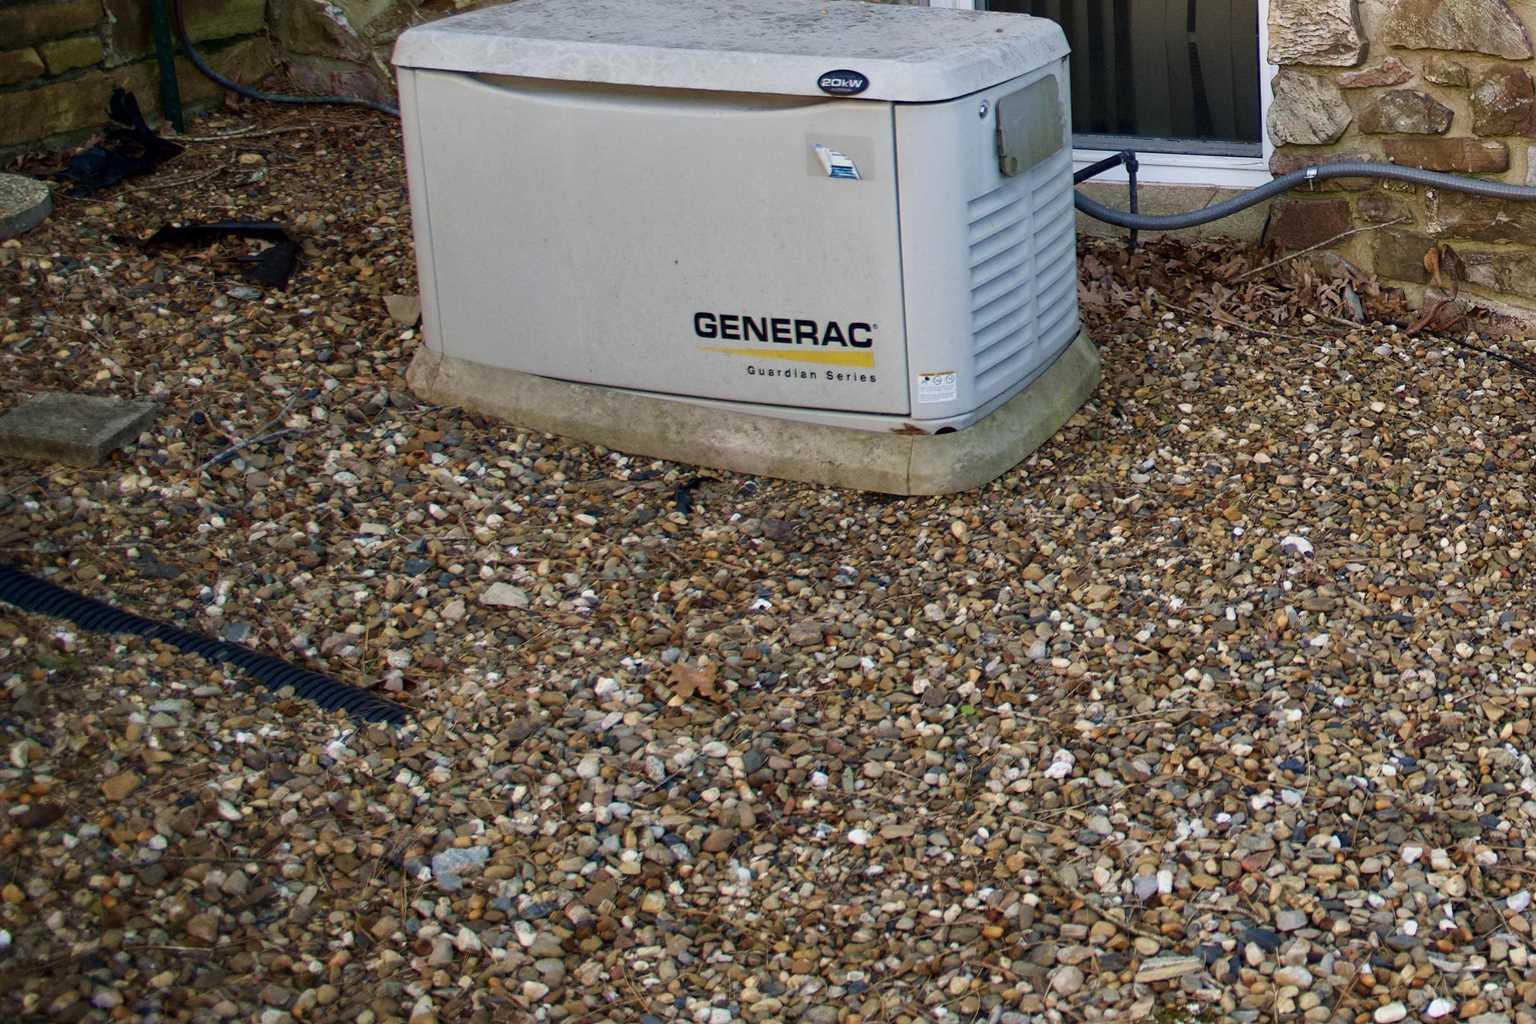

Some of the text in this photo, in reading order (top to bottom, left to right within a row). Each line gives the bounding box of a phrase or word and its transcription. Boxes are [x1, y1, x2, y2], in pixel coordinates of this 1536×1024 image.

[822, 78, 863, 88] 20kW
[694, 312, 873, 348] GENERAC
[747, 365, 877, 383] Guardian Series
